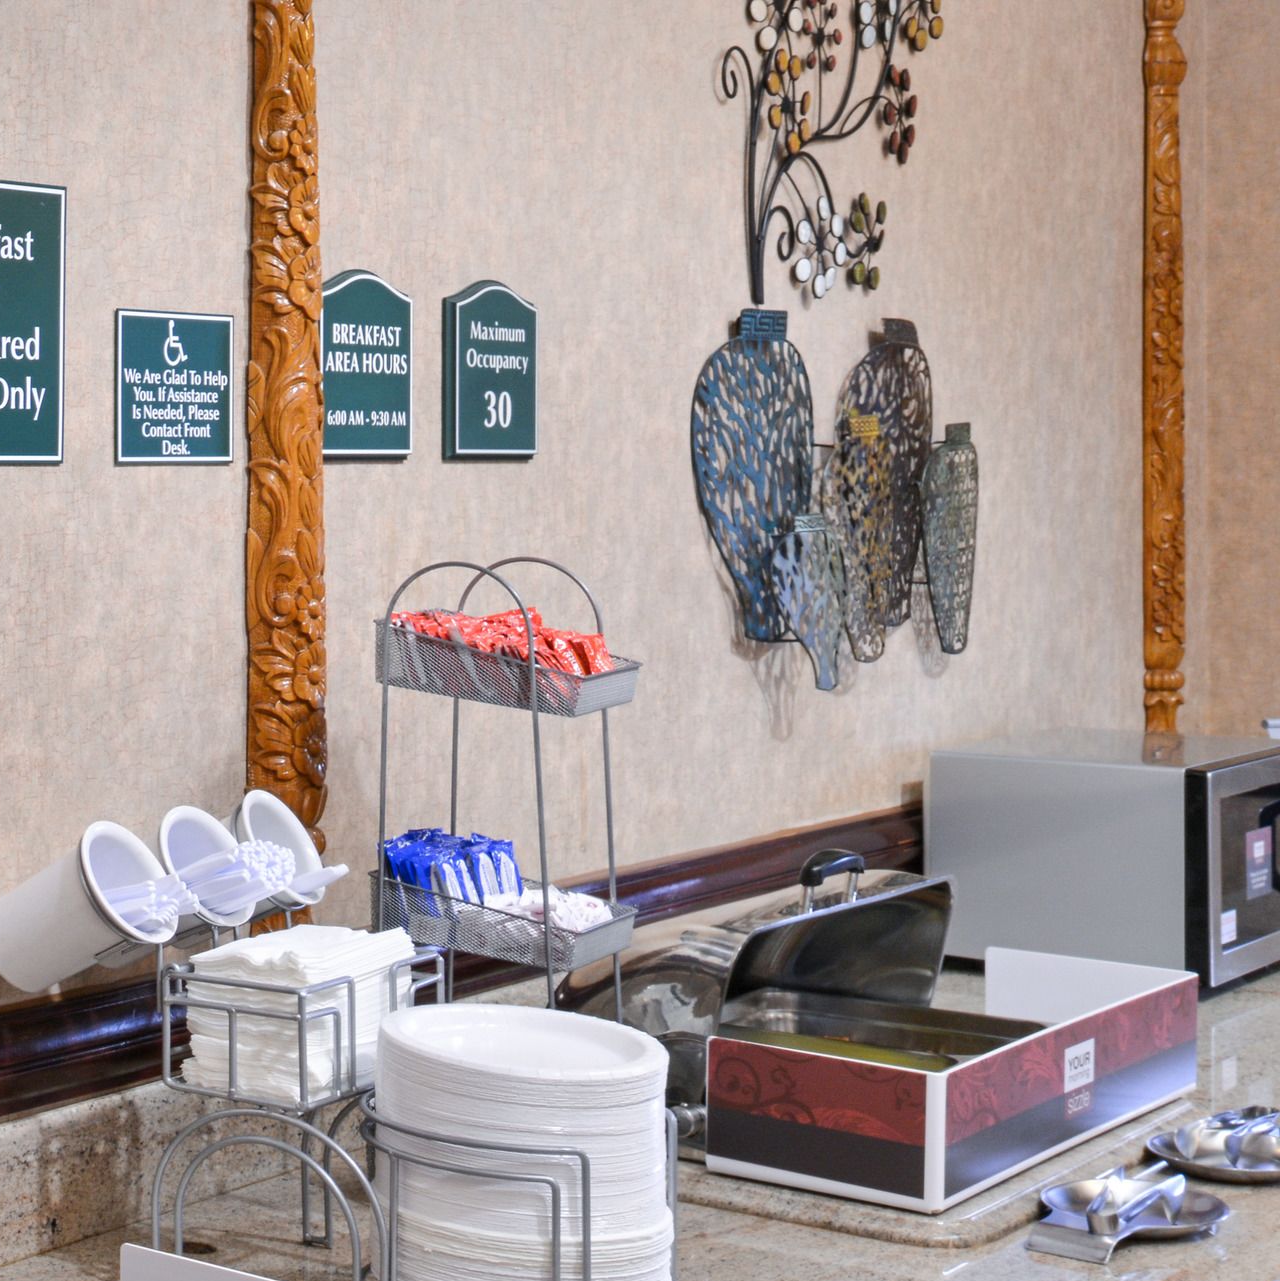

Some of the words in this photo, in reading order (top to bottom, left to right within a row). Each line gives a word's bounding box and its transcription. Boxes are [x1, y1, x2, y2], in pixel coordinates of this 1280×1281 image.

[332, 322, 402, 347] BREAKFAST
[469, 320, 526, 343] Maximum
[325, 351, 360, 373] AREA
[362, 352, 408, 375] HOURS
[465, 347, 529, 375] Occupancy
[123, 368, 142, 384] We
[143, 368, 161, 384] Are
[163, 368, 188, 385] Glad
[188, 369, 202, 386] To
[203, 370, 228, 391] Help
[133, 386, 156, 402] You.
[158, 386, 167, 402] If
[167, 386, 219, 403] Assistance
[132, 404, 142, 419] Is
[143, 403, 186, 422] Needed,
[188, 404, 220, 421] Please
[327, 410, 347, 426] 6:00
[348, 410, 365, 426] AM
[370, 410, 390, 426] 9:30
[391, 411, 407, 426] AM
[483, 390, 512, 429] 30
[141, 421, 183, 438] Contact
[183, 422, 212, 438] Front
[162, 439, 191, 455] Desk.
